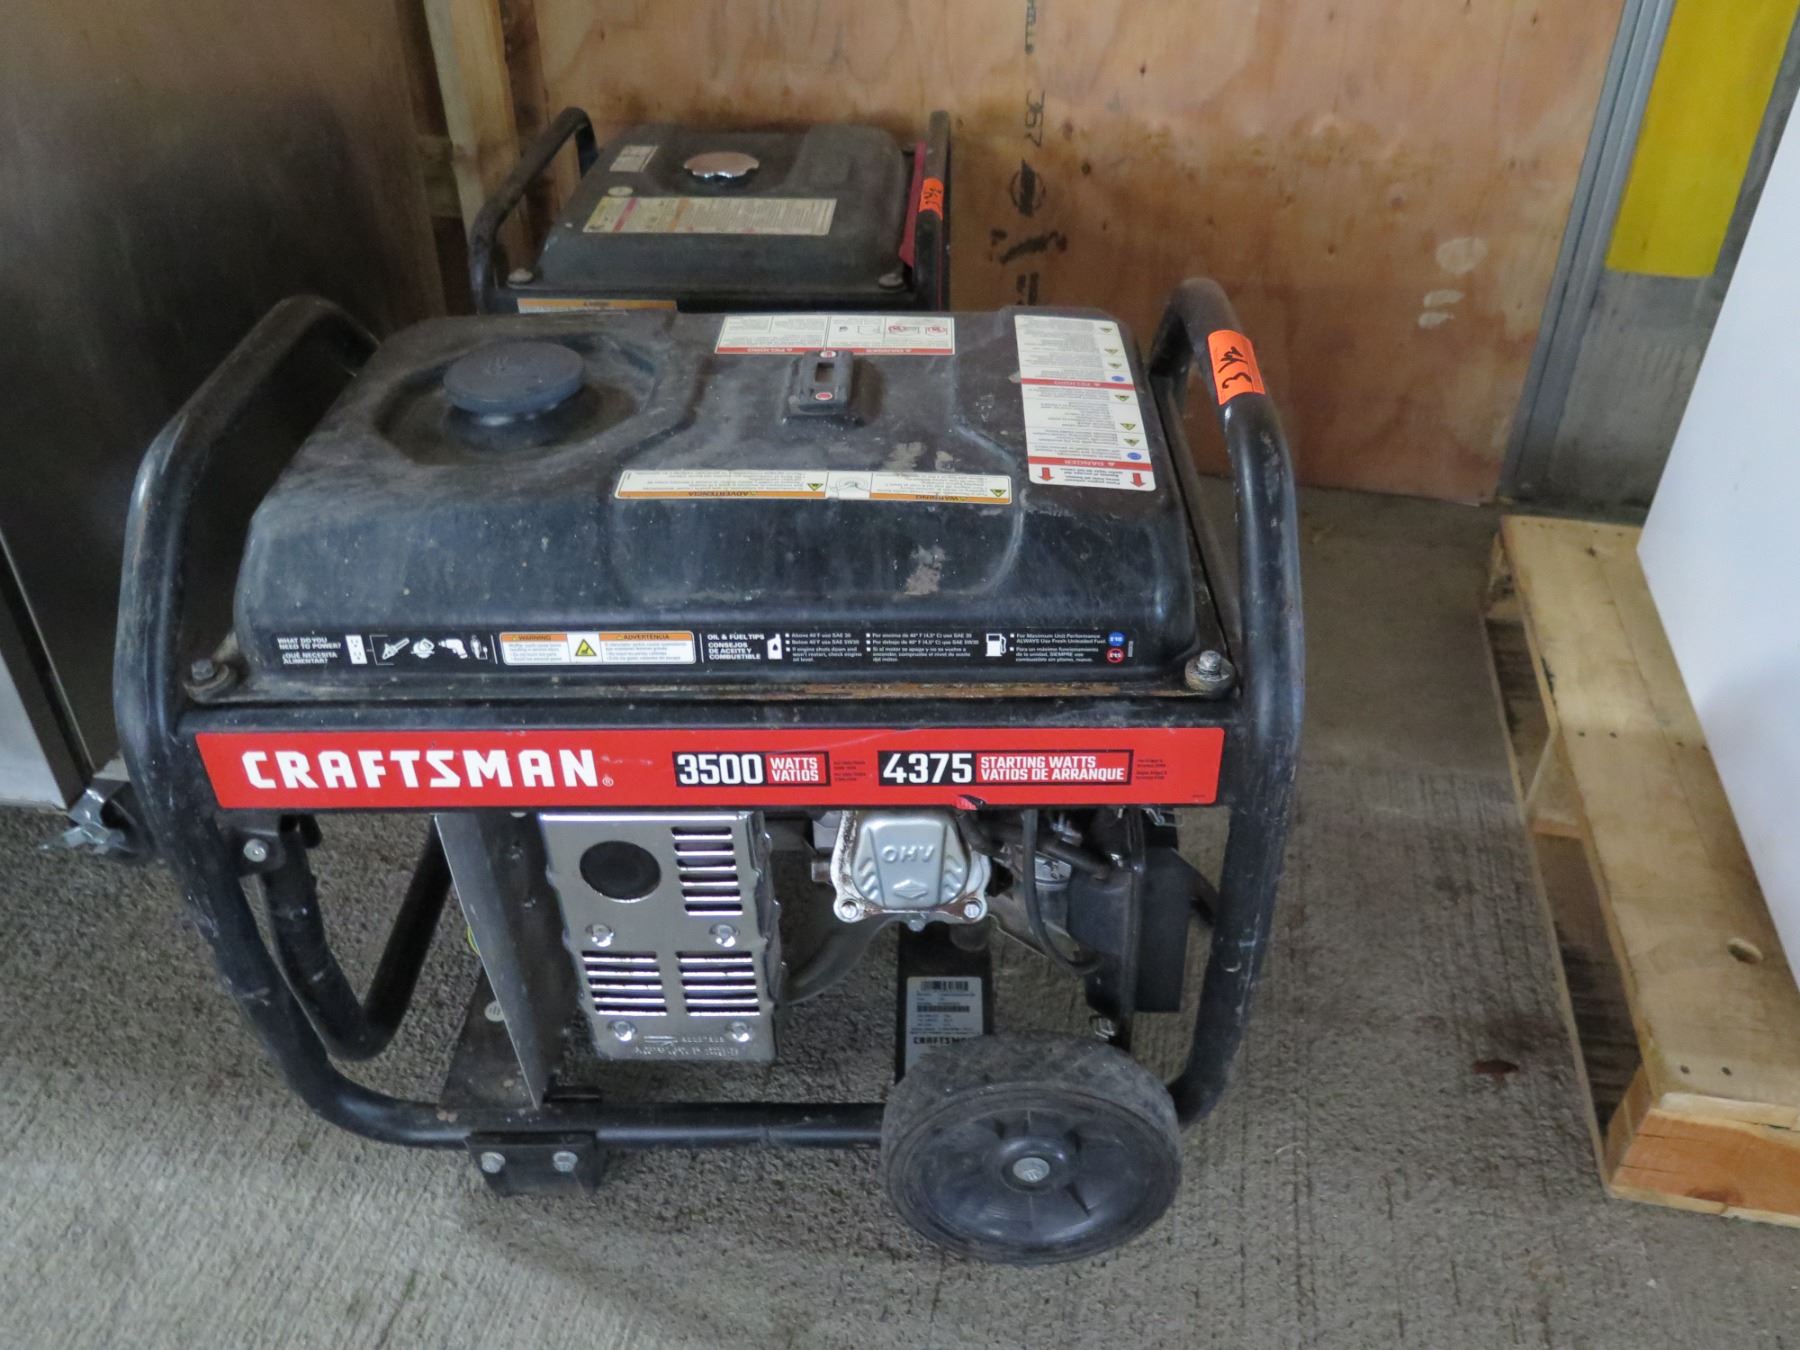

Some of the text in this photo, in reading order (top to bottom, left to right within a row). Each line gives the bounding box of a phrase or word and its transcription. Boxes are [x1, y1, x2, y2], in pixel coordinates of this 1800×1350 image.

[1064, 459, 1104, 467] DANGER
[623, 633, 669, 641] ADVERTENCIA
[676, 753, 764, 785] 3500
[770, 757, 818, 769] WATTS
[883, 753, 972, 784] 4375
[980, 756, 1096, 769] STARTING WATTS
[771, 769, 819, 782] VATIOS
[981, 769, 1029, 781] VATIOS
[1032, 769, 1049, 781] DE
[1051, 768, 1125, 781] ARRANQUE
[882, 845, 934, 863] OHV
